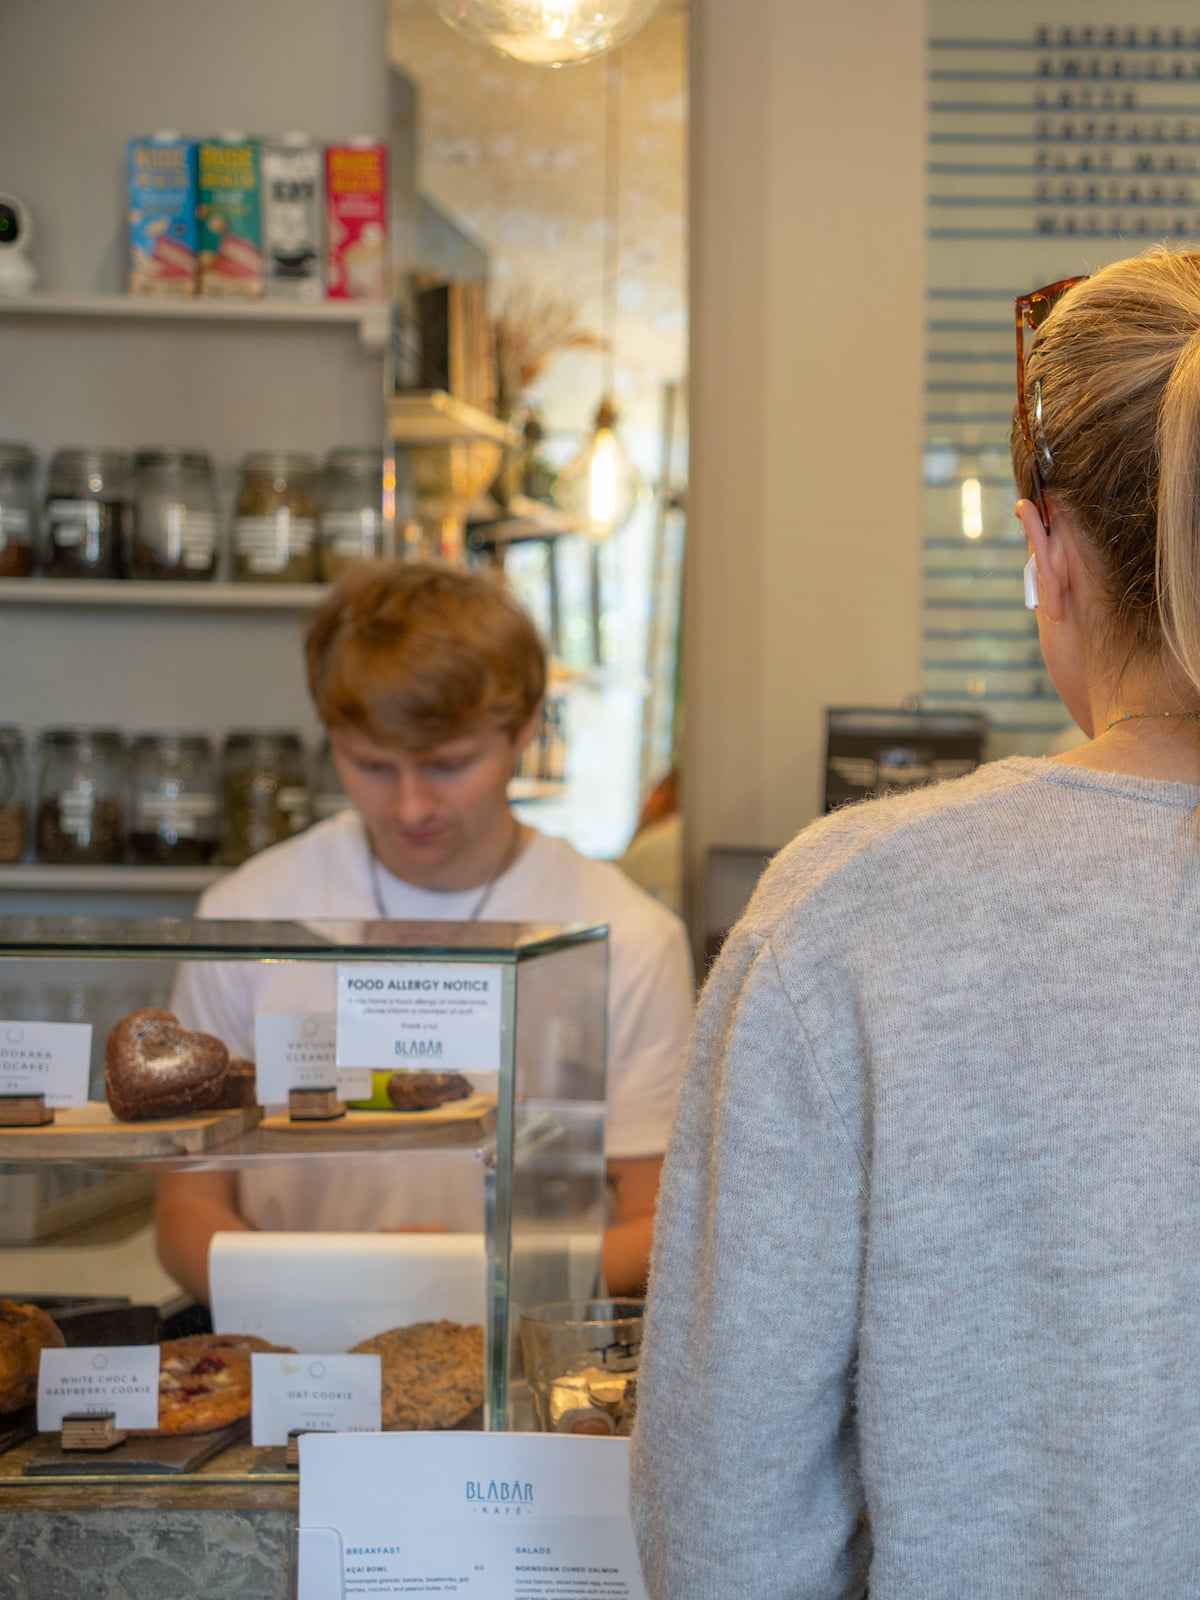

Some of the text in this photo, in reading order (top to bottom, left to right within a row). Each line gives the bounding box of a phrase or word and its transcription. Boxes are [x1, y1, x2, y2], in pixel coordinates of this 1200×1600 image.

[1036, 89, 1138, 110] LATTE
[348, 979, 489, 991] FOOD ALLERGY NOTICE
[60, 1376, 93, 1385] WHITE
[98, 1375, 128, 1384] CHOC
[46, 1385, 152, 1396] RASPBERRY COOKIE
[287, 1391, 353, 1400] OAT COOKIE
[346, 1547, 401, 1556] BREAKFAST
[515, 1547, 551, 1555] SALADS
[561, 1566, 586, 1574] CURED
